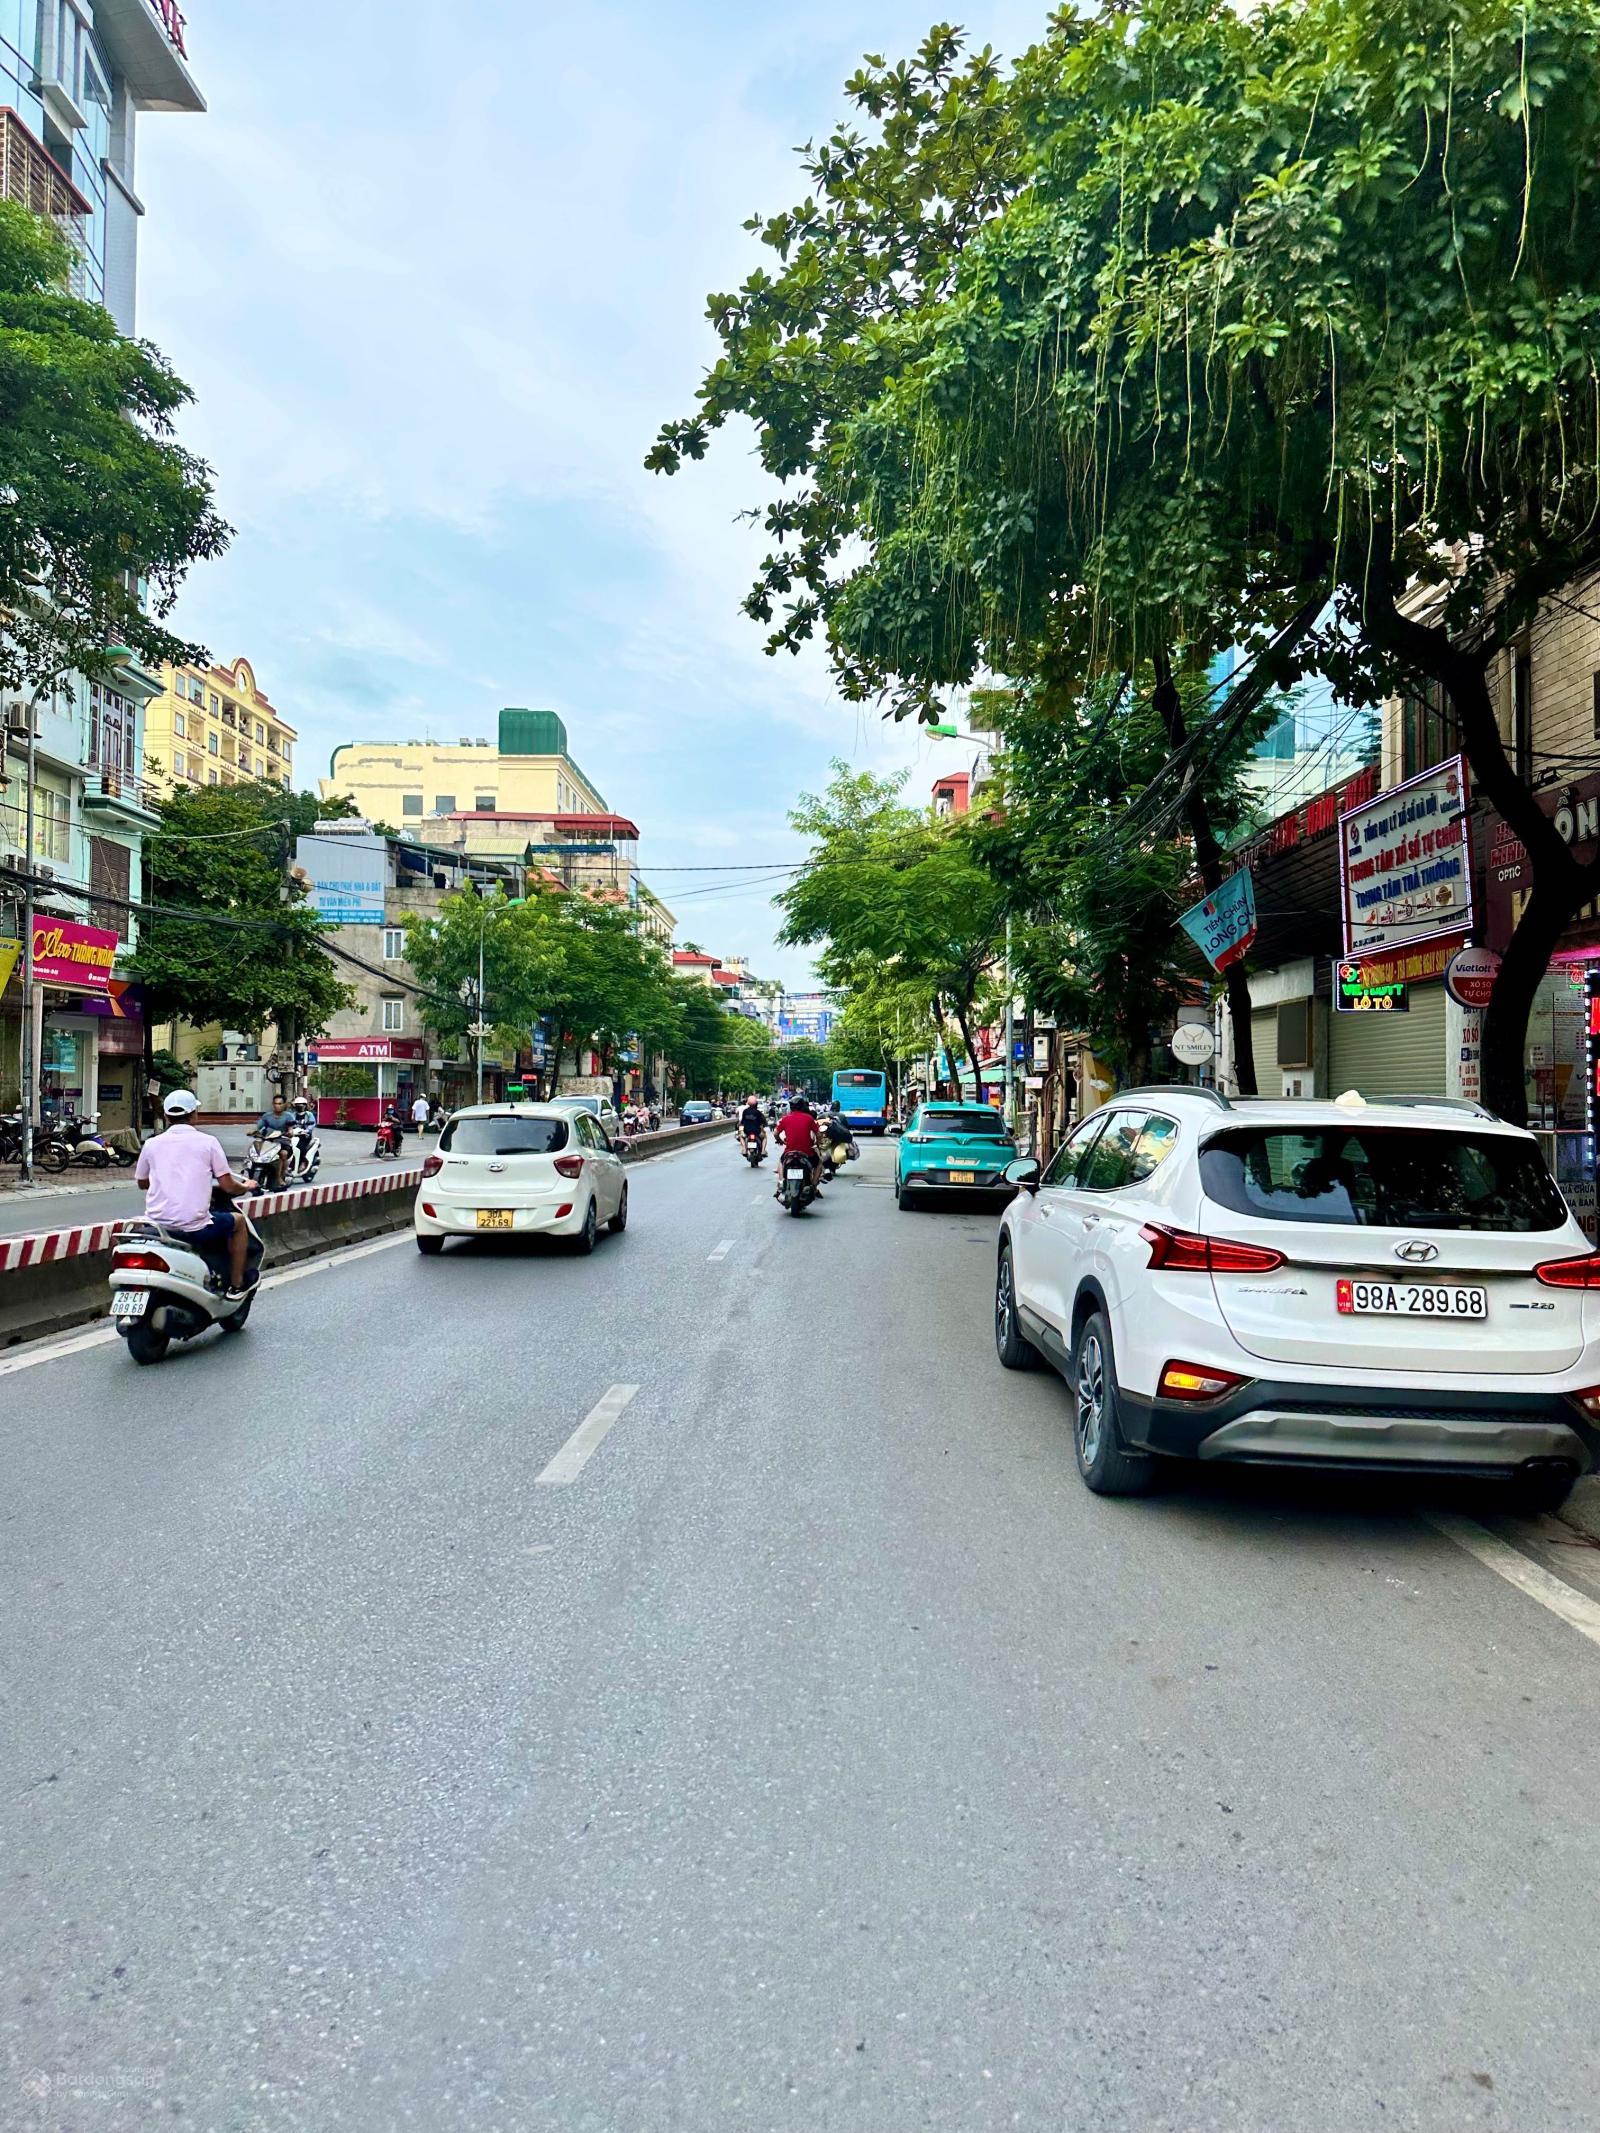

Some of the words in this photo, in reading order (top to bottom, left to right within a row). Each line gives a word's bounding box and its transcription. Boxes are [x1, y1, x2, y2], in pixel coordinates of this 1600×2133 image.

[1498, 865, 1521, 882] OPTIC
[1204, 924, 1237, 954] LONG
[1456, 964, 1491, 973] Vietlott
[358, 1045, 388, 1056] ATM
[1356, 1285, 1483, 1315] 98A-289.68
